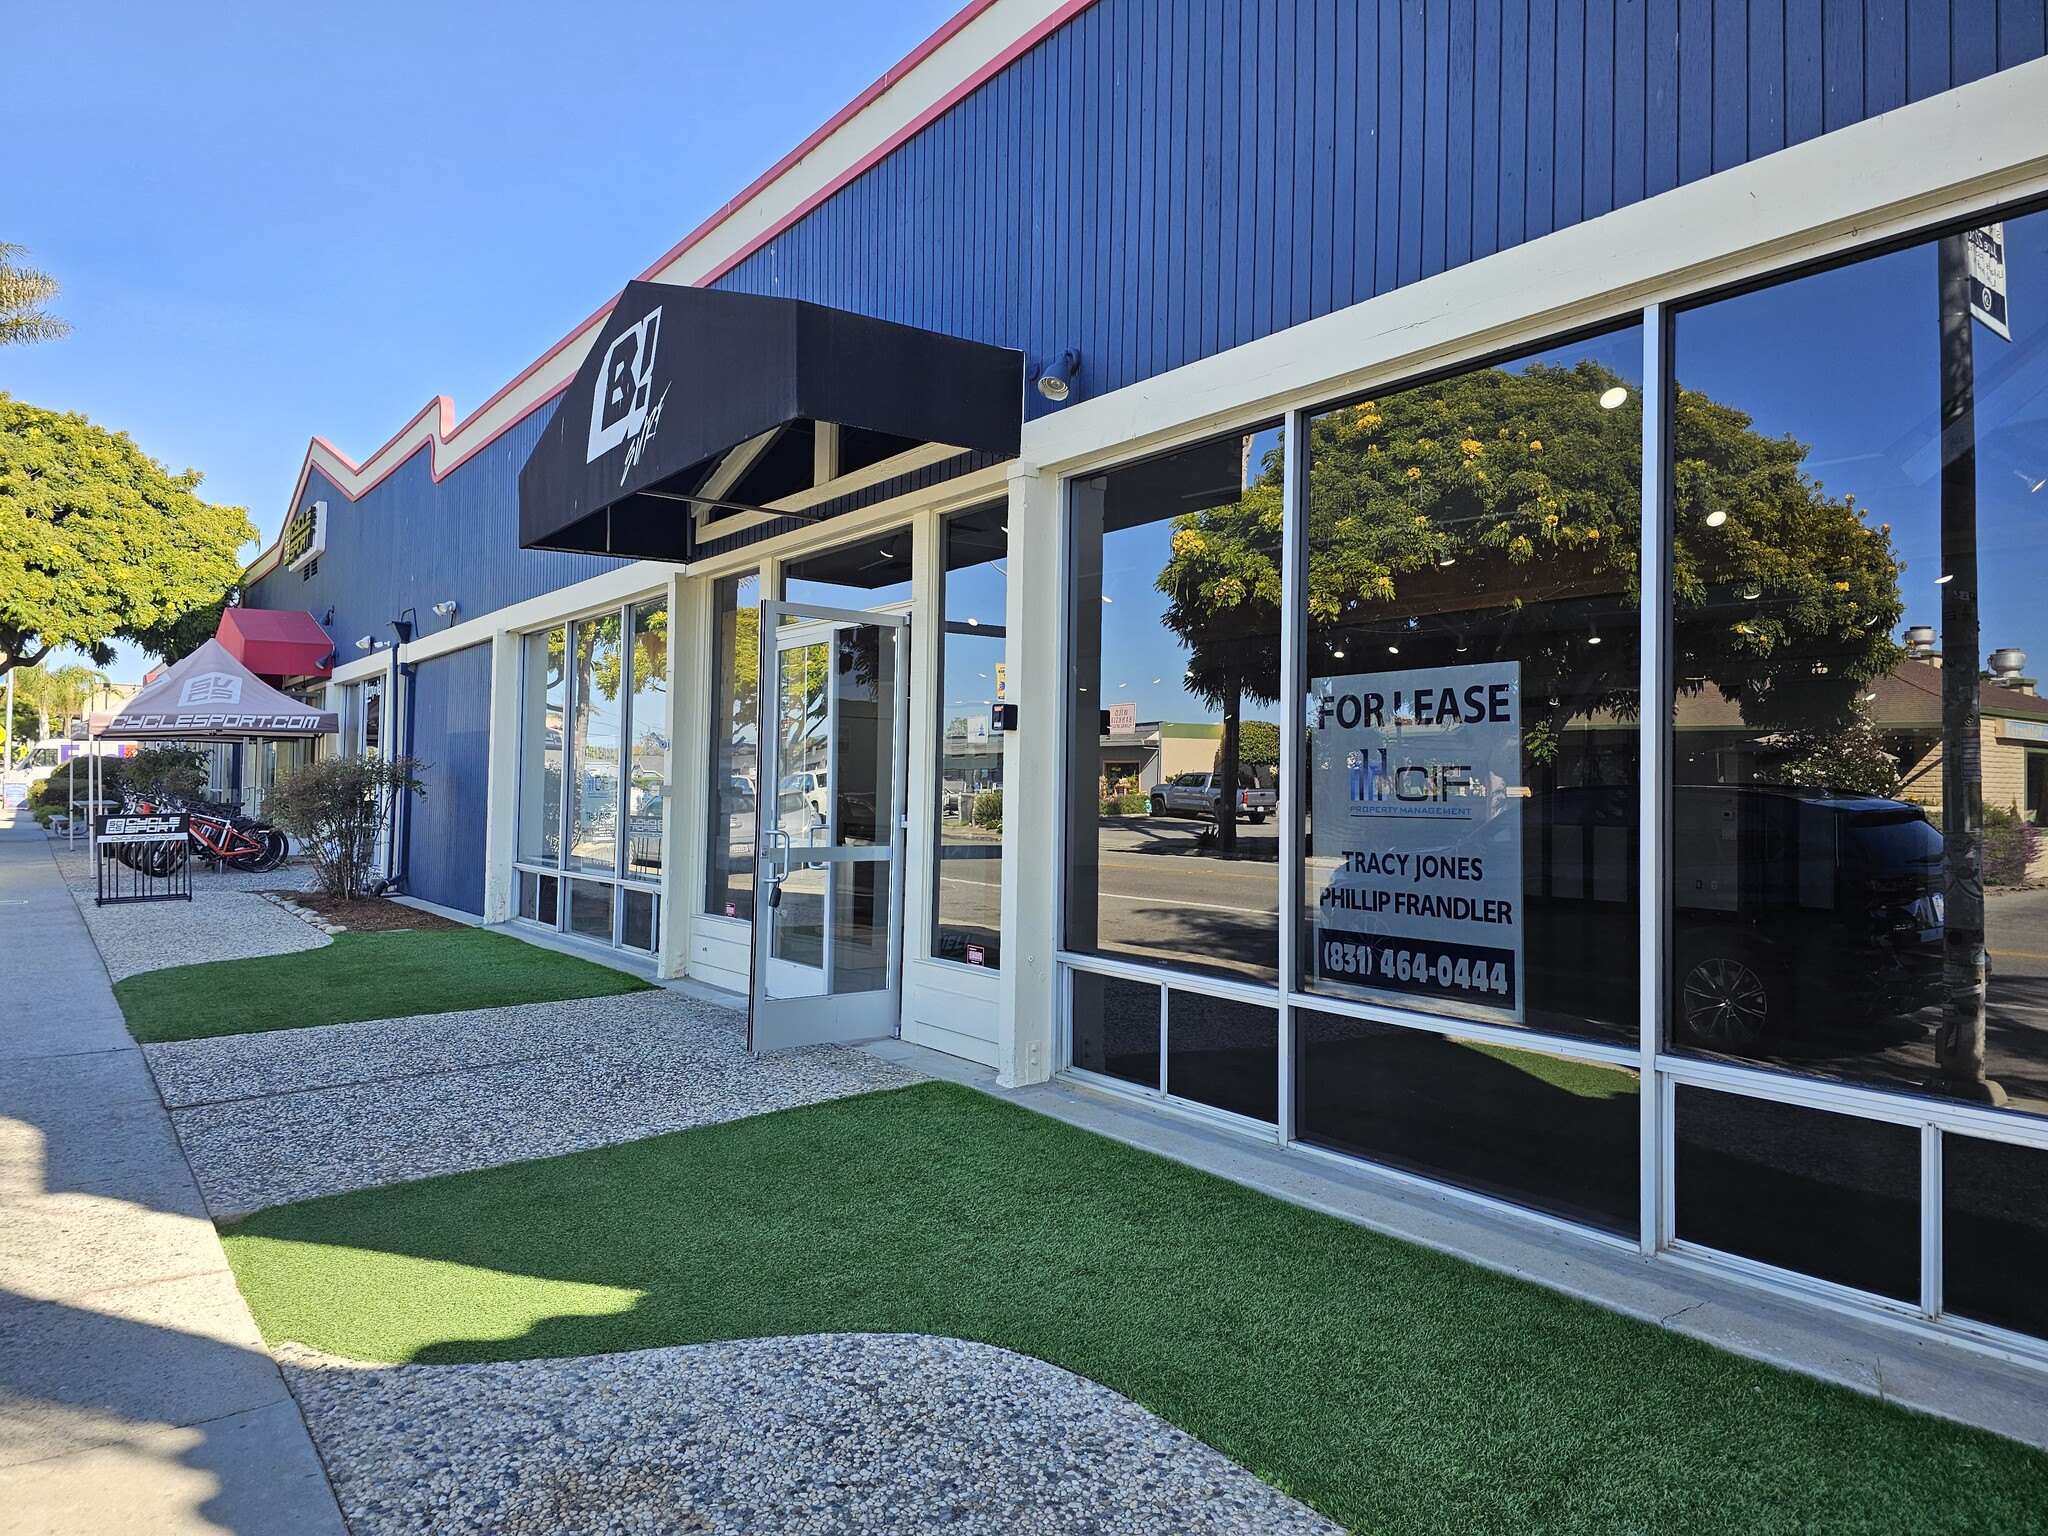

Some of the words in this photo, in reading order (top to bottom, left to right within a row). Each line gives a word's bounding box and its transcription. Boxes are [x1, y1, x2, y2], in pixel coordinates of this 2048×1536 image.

[1318, 692, 1386, 730] FOR
[1393, 683, 1511, 726] LEASE
[108, 713, 321, 730] CYCLESPORT.COM
[125, 816, 181, 825] CYCLE
[1350, 805, 1398, 814] PROPERTY
[1399, 806, 1472, 815] MANAGEMENT
[124, 824, 180, 834] SPORT
[1341, 850, 1410, 876] TRACY
[1413, 854, 1483, 883] JONES
[1319, 887, 1391, 912] PHILLIP
[1394, 891, 1514, 925] FRANDLER
[1323, 941, 1373, 975] (831)
[1380, 948, 1508, 995] 464-0444
